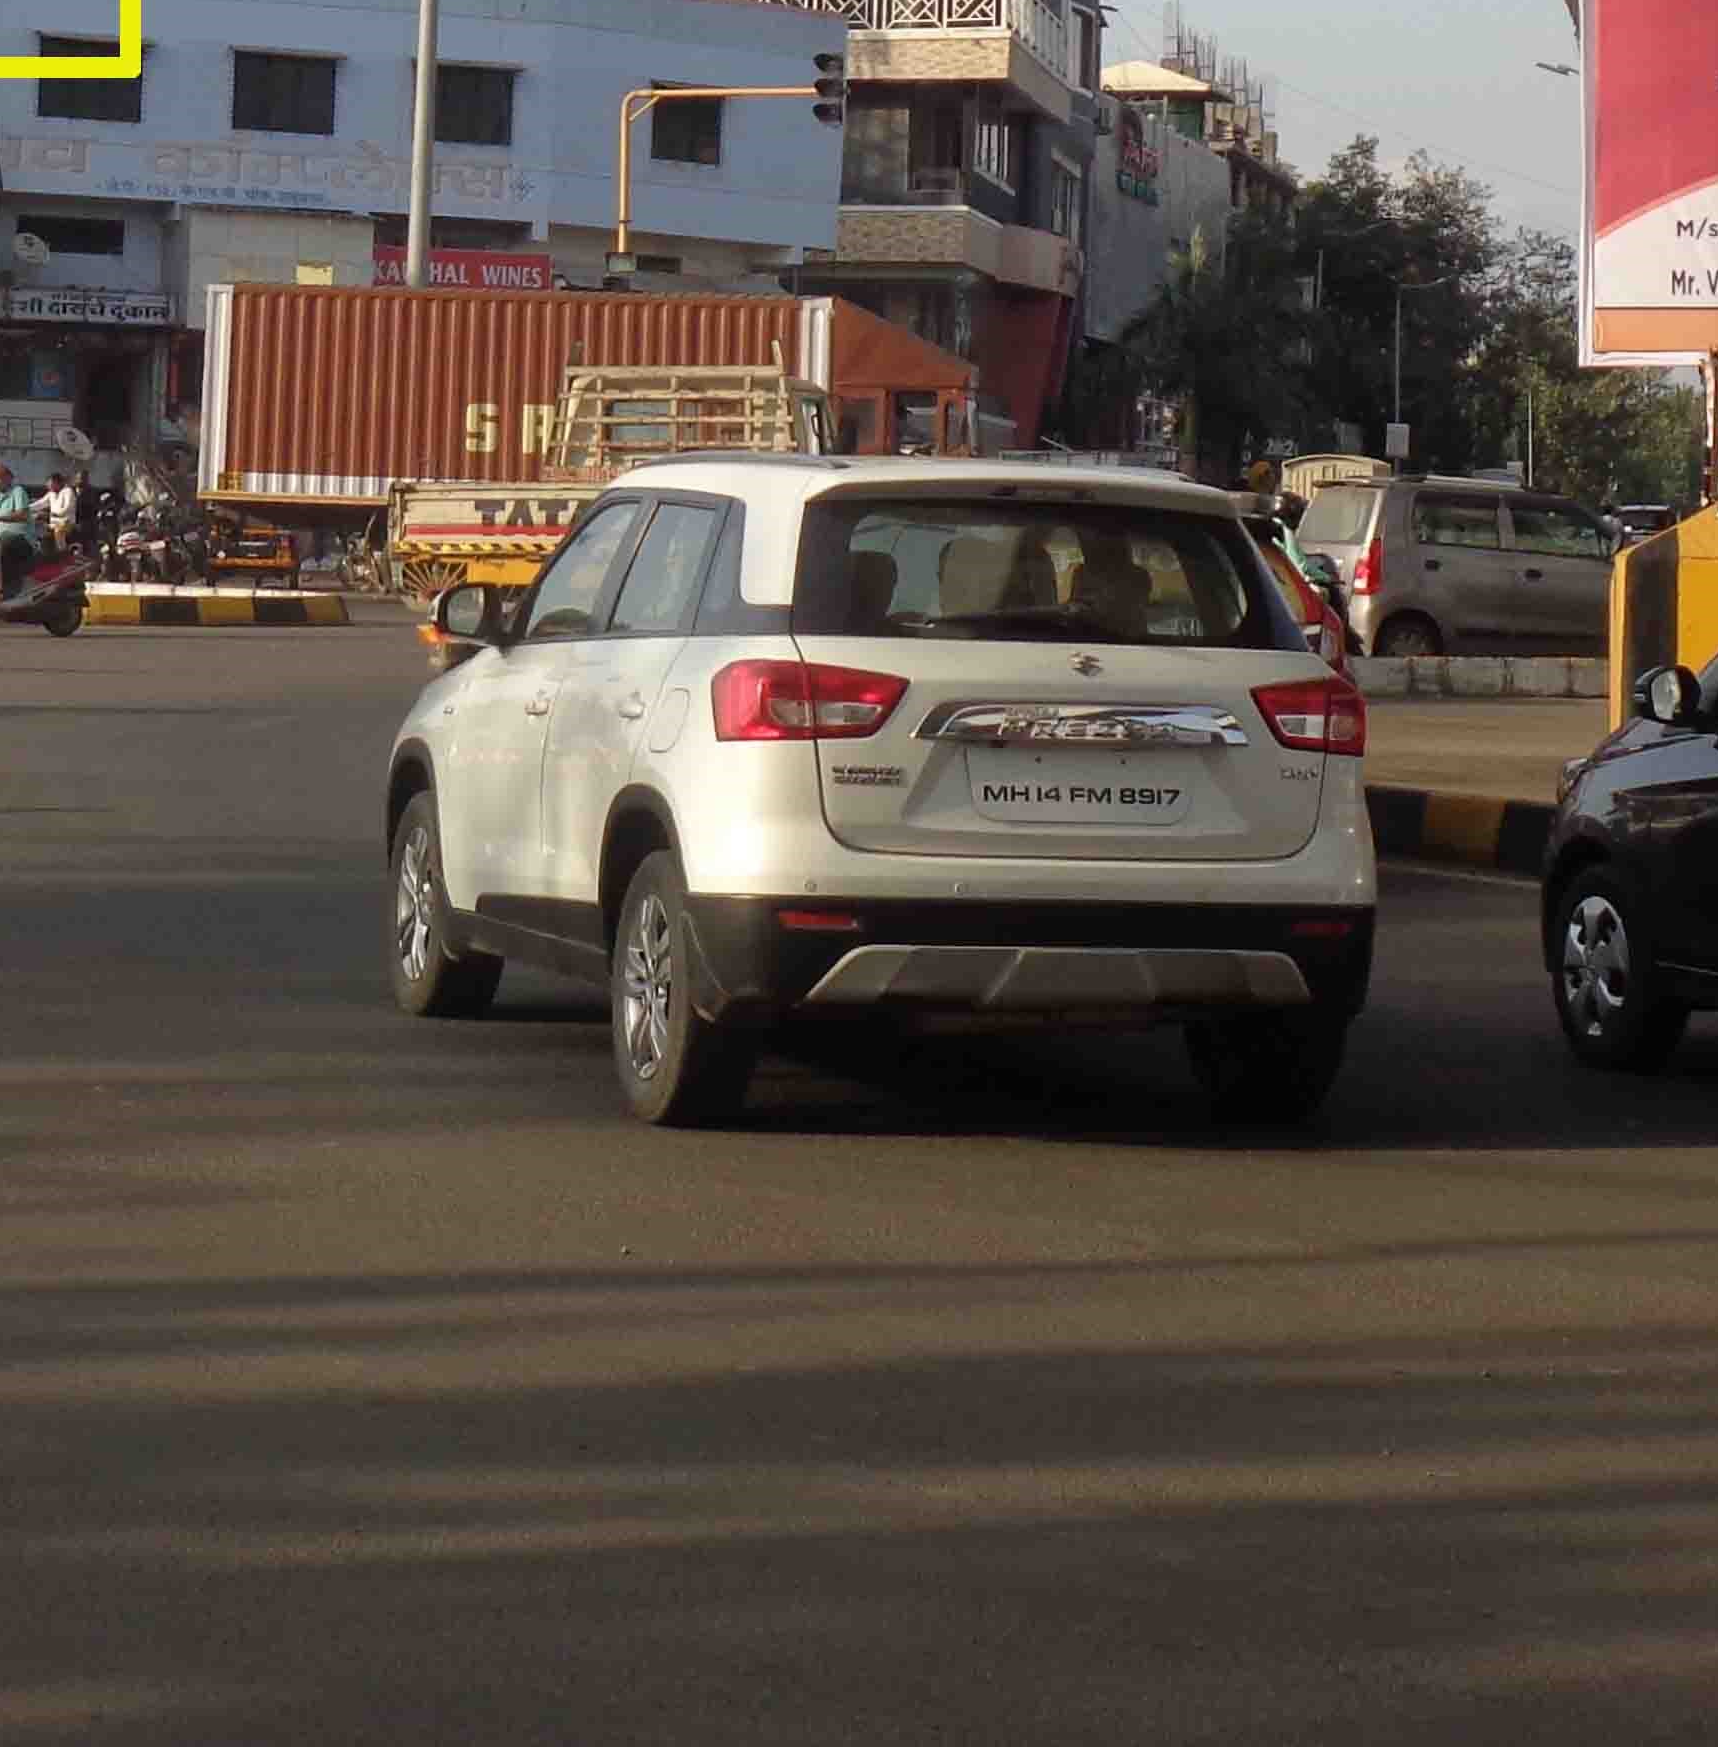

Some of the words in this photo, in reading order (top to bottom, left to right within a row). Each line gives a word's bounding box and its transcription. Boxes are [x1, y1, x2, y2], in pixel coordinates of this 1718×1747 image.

[374, 259, 469, 286] KAHAL
[481, 264, 543, 289] WINES
[1671, 269, 1700, 297] Mr.
[472, 499, 591, 528] TAT
[983, 785, 1032, 804] MH
[1036, 786, 1063, 804] 14
[1071, 786, 1112, 806] FM
[1119, 786, 1181, 807] 8917
